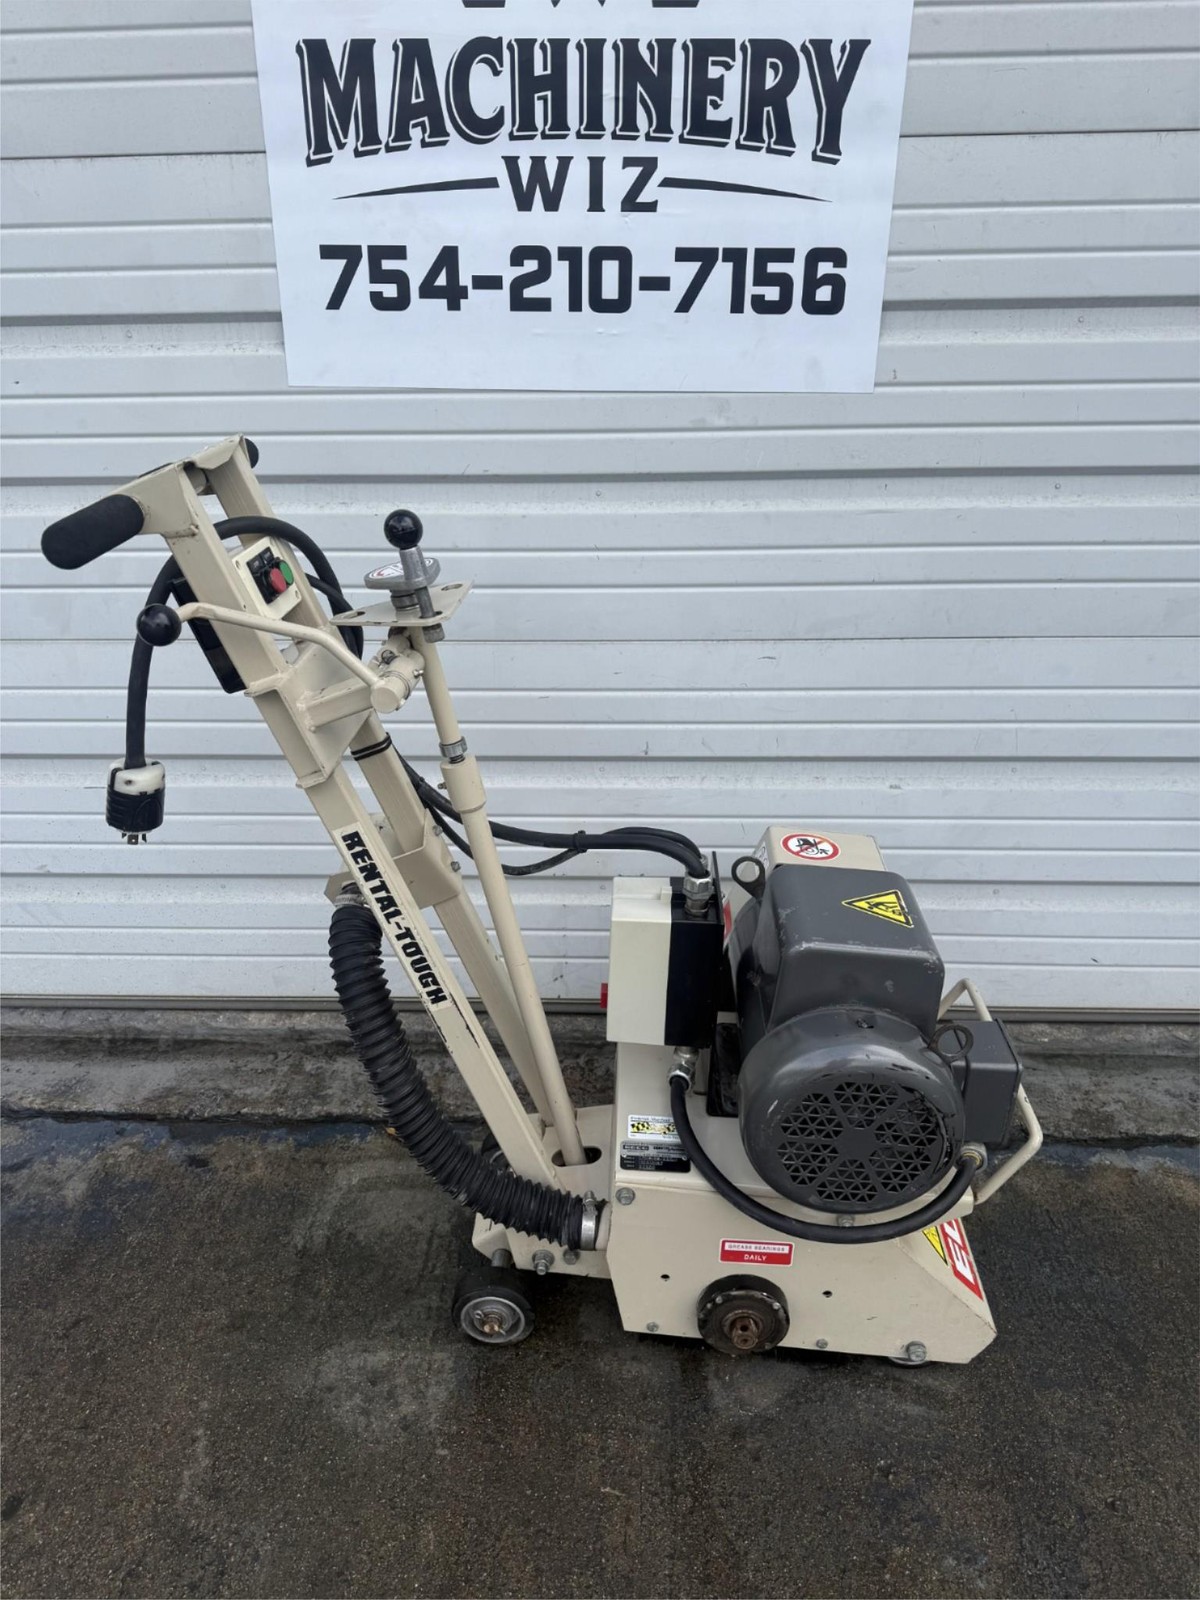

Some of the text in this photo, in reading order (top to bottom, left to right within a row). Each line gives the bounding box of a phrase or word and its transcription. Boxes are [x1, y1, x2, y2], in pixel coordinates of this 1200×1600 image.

[296, 36, 871, 167] MACHINERY
[502, 155, 658, 213] WIZ
[319, 244, 847, 315] 754-210-7156
[341, 830, 448, 1005] RENTAL-TOUGH
[743, 1253, 767, 1261] DAILY
